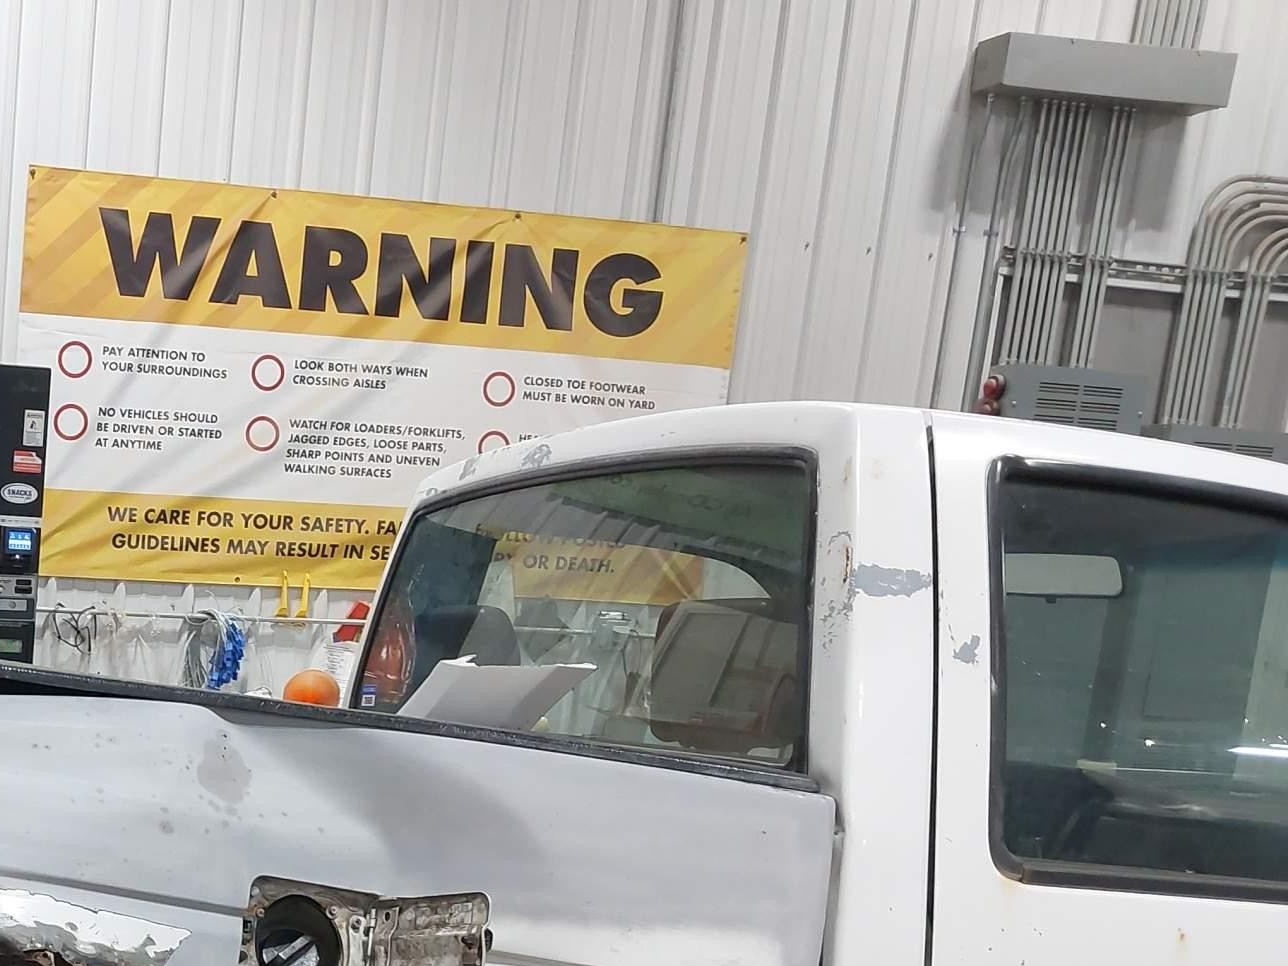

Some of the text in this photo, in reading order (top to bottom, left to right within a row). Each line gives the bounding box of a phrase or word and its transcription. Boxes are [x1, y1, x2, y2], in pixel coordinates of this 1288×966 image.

[99, 207, 664, 338] WARNING
[102, 345, 206, 362] PAY ATTENTION TO
[102, 361, 228, 379] YOUR SURROUNDINGS
[294, 359, 428, 378] LOOK BOTH WAYS WHEN
[293, 375, 386, 390] CROSSING AISLES
[524, 376, 646, 395] CLOSED TOE FOOTWEAR
[522, 391, 655, 410] MUST BE WORN ON YARD
[98, 407, 218, 424] NO VEHICLES SHOULD
[96, 422, 222, 440] BE DRIVEN OR STARTED
[289, 418, 465, 441] WATCH FOR LOADERS/FORKLIFTS,
[95, 438, 162, 451] AT ANYTIME
[287, 434, 447, 454] JAGGED EDGES, LOOSE PARTS,
[285, 449, 440, 467] SHARP POINTS AND UNEVEN
[284, 463, 392, 478] WALKING SURFACES
[108, 506, 137, 523] WE
[144, 508, 190, 526] CARE
[197, 511, 233, 528] FOR
[241, 513, 293, 531] YOUR
[301, 516, 370, 535] SAFETY.
[112, 533, 220, 554] GUIDELINES
[226, 538, 269, 556] MAY
[275, 541, 338, 559] RESULT
[343, 544, 364, 560] IN
[522, 553, 549, 570] OR
[555, 556, 616, 574] DEATH.
